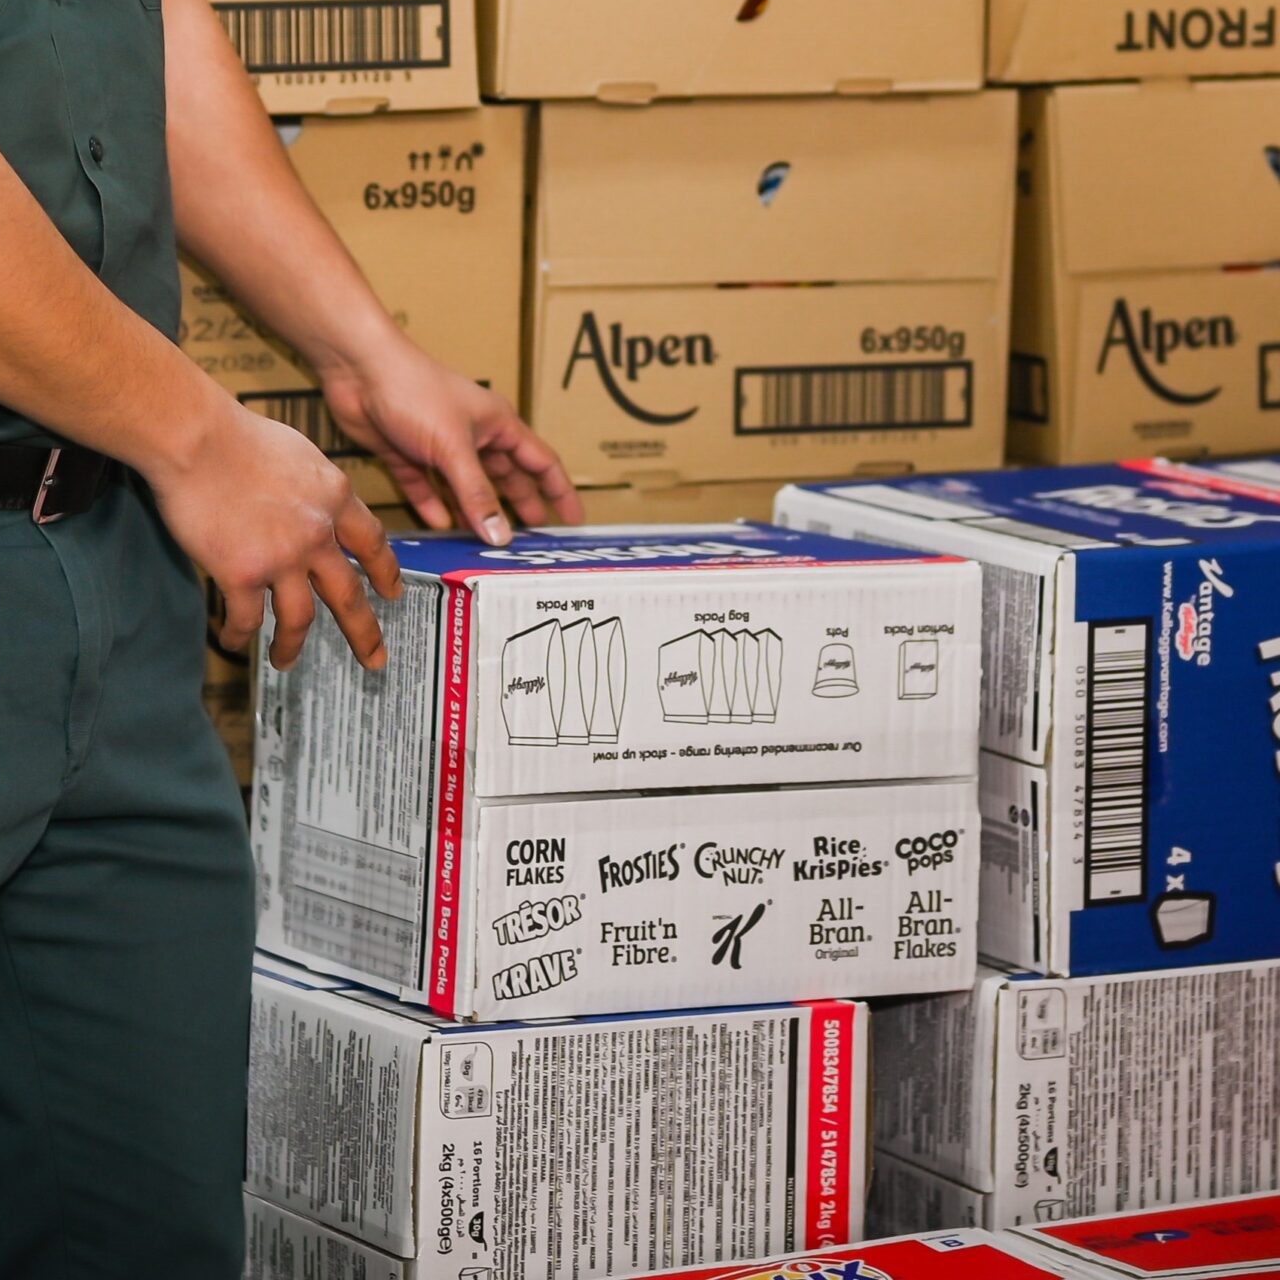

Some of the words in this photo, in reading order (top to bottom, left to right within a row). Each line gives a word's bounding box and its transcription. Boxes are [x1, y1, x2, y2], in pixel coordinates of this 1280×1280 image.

[1116, 7, 1277, 52] FRONT
[364, 182, 476, 212] 6x950g
[860, 326, 966, 357] 6x950g
[1096, 297, 1234, 405] Alpen
[562, 310, 713, 426] Alpen
[536, 600, 569, 612] Packs
[572, 599, 594, 612] Bulk
[728, 610, 750, 623] Bag
[1192, 558, 1235, 666] Vantage
[694, 612, 726, 625] Packs
[884, 625, 914, 637] Packs
[916, 624, 954, 636] Portion
[452, 588, 467, 685] 5008347854
[826, 627, 849, 638] Pots
[1157, 561, 1175, 752] www.Kelloggsvantage.com
[506, 675, 546, 697] Kellogg's
[662, 670, 698, 688] Kellogg's
[1075, 666, 1086, 698] 050
[448, 701, 462, 769] 5147854
[842, 741, 862, 754] Our
[1074, 714, 1086, 770] 50083
[592, 750, 619, 762] now!
[622, 747, 637, 759] up
[639, 748, 667, 760] stock
[678, 744, 711, 757] range
[714, 744, 758, 758] catering
[761, 742, 839, 757] recommended
[445, 773, 459, 801] 2kg
[445, 807, 459, 823] (4
[1073, 785, 1085, 840] 47854
[446, 827, 454, 837] x
[506, 838, 566, 866] CORN
[813, 837, 861, 858] Rice
[1168, 847, 1191, 865] 4
[598, 843, 681, 894] FROSTIES
[694, 841, 785, 880] CRUNCHY
[907, 848, 954, 877] pops
[1073, 857, 1083, 865] 3
[506, 866, 564, 886] FLAKES
[1166, 874, 1185, 892] x
[816, 898, 864, 922] All-
[905, 890, 953, 915] All-
[438, 906, 452, 941] Bag
[492, 895, 582, 947] TRÉSOR
[600, 917, 678, 944] Fruit'n
[809, 921, 866, 946] Bran
[898, 915, 955, 937] Bran
[815, 947, 859, 962] Original
[894, 938, 957, 961] Flakes
[436, 945, 450, 996] Packs
[492, 949, 577, 1001] KRAVE
[820, 1019, 840, 1113] 5008347854
[1016, 1083, 1031, 1110] 2kg
[1047, 1081, 1056, 1094] 16
[1047, 1097, 1056, 1143] Portions
[439, 1144, 454, 1172] 2kg
[472, 1141, 482, 1156] 16
[819, 1130, 837, 1196] 5147854
[472, 1158, 482, 1207] Portions
[786, 1177, 794, 1236] NUTRITIONAL
[816, 1201, 833, 1229] 2kg
[471, 1218, 481, 1237] 30g
